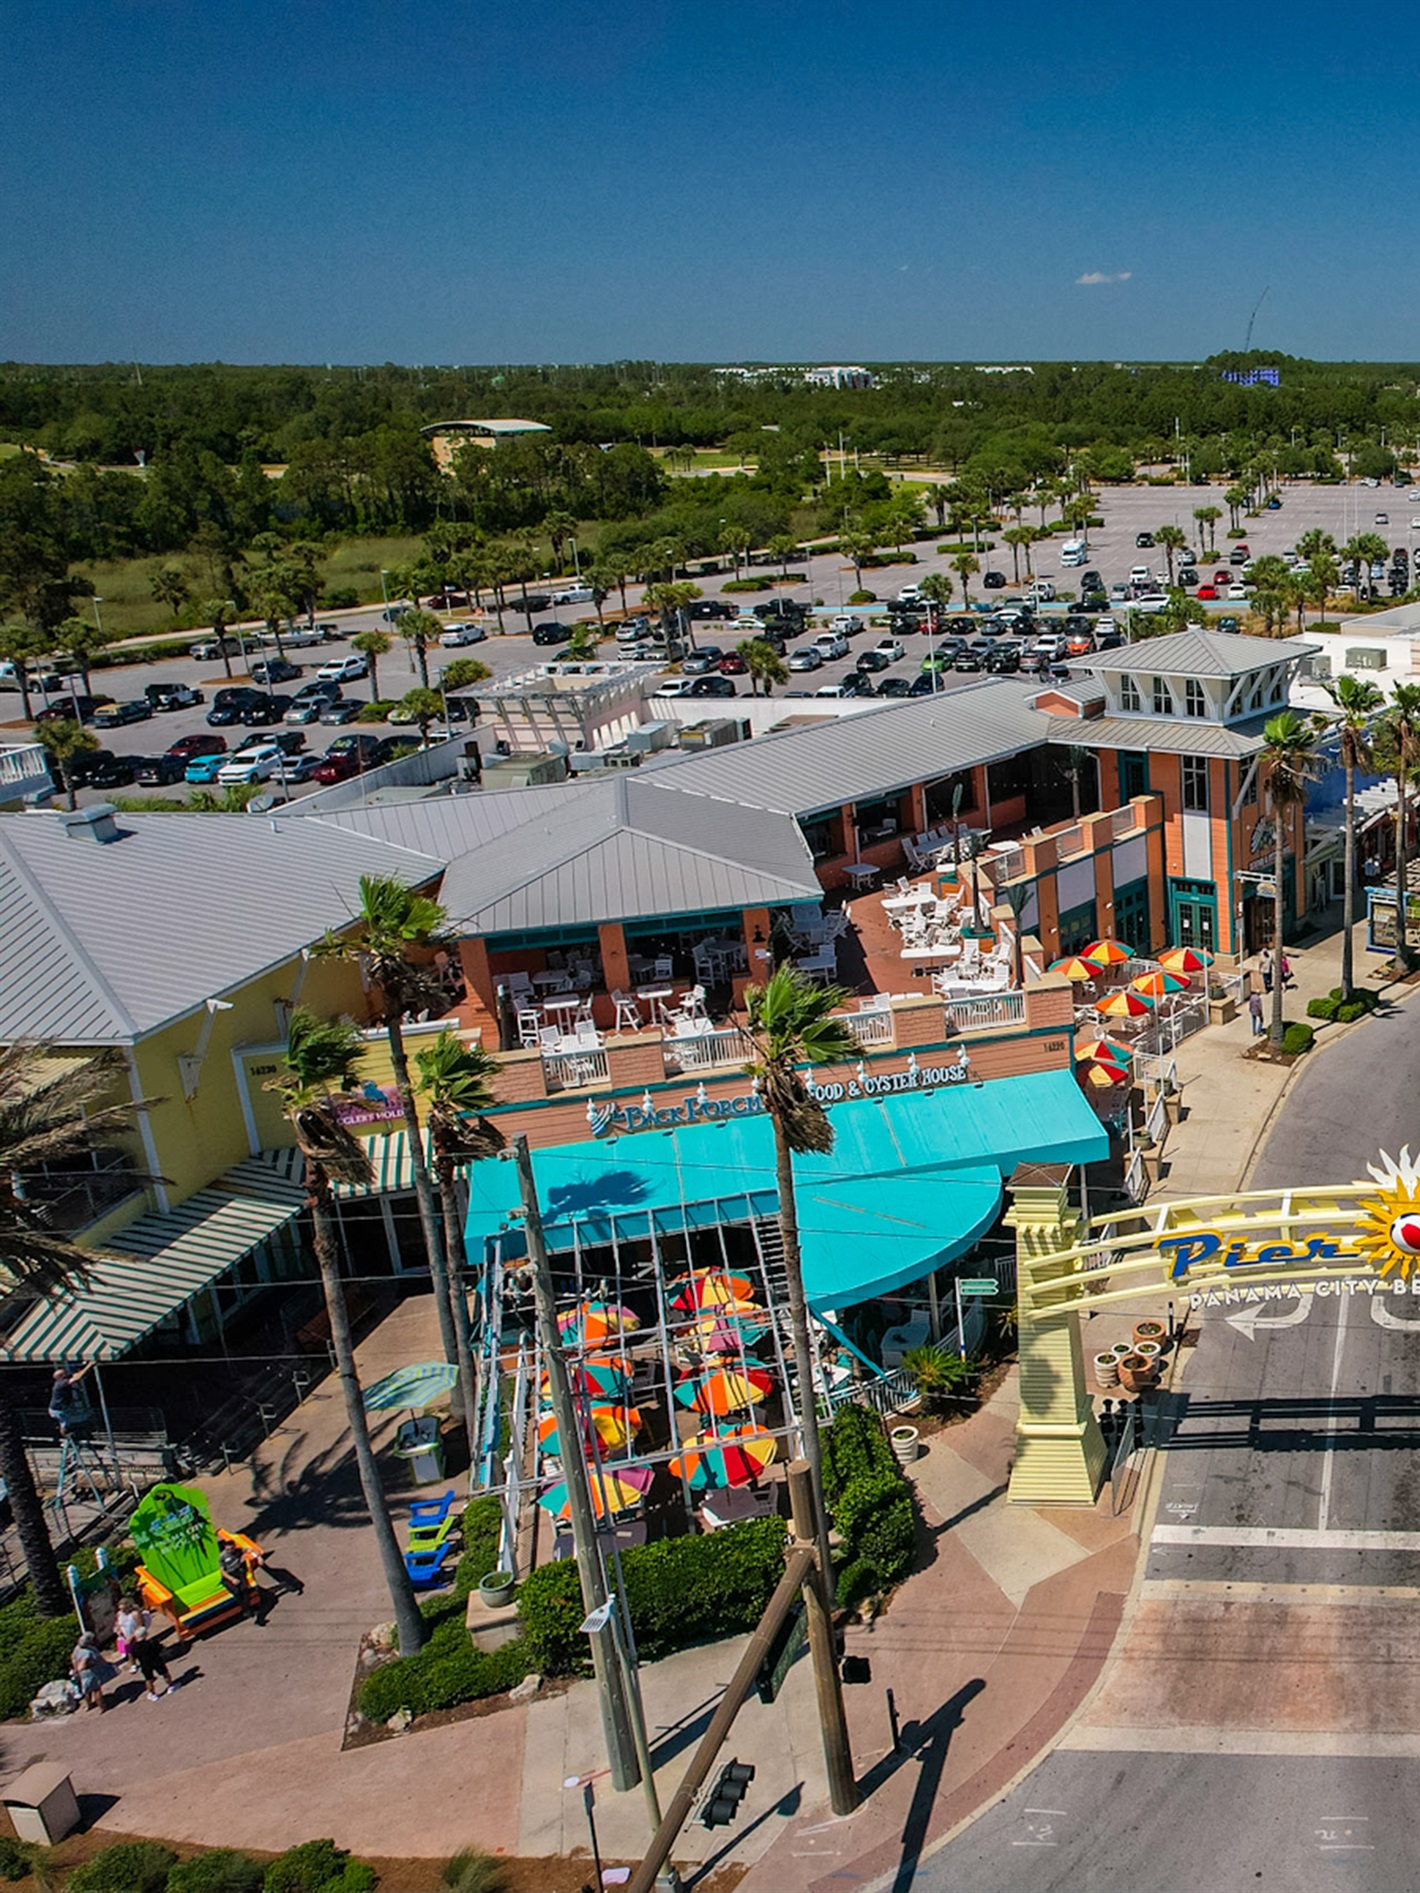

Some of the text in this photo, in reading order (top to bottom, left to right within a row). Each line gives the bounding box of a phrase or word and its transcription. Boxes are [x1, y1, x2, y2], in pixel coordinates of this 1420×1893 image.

[848, 1081, 862, 1097] &
[864, 1073, 919, 1095] OYSTER
[921, 1064, 968, 1086] HOUSE
[624, 1104, 685, 1130] BACK
[684, 1095, 763, 1122] PORCH
[1152, 1228, 1364, 1278] Pier
[1188, 1283, 1302, 1310] PANAMA
[1314, 1278, 1379, 1297] CITY
